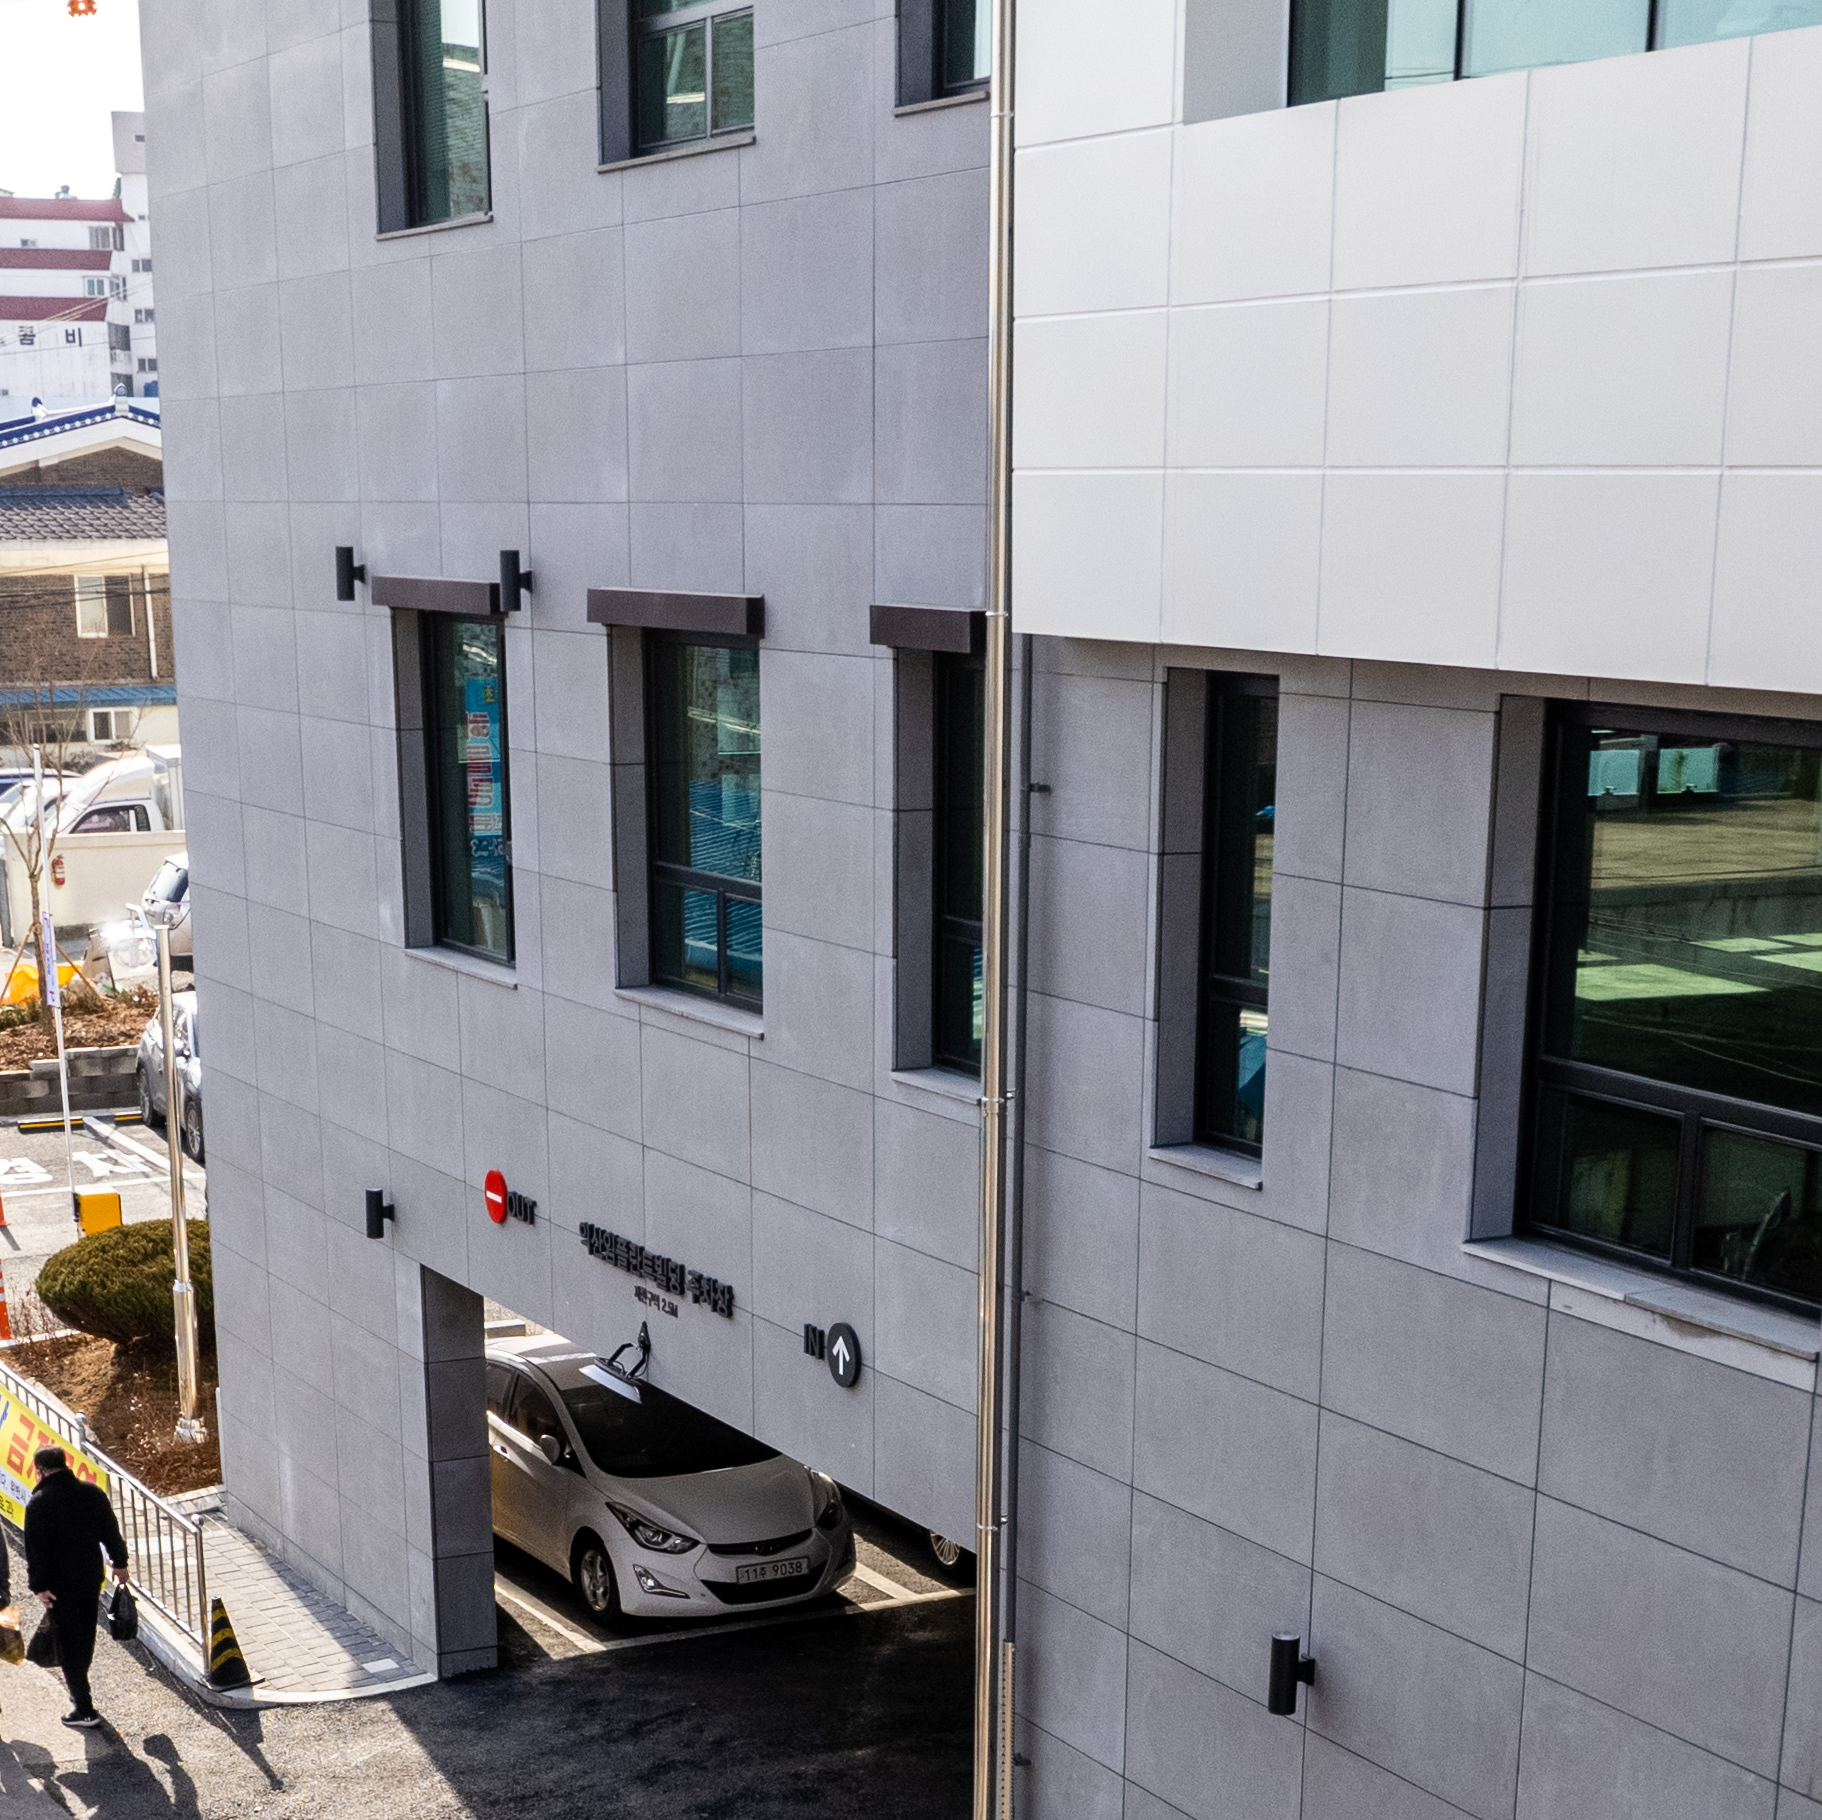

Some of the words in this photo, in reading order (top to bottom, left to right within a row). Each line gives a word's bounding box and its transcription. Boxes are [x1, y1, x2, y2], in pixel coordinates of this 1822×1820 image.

[507, 1190, 537, 1225] OUT
[687, 1269, 735, 1319] 주차장
[803, 1323, 825, 1360] IN
[772, 1560, 803, 1577] 9038
